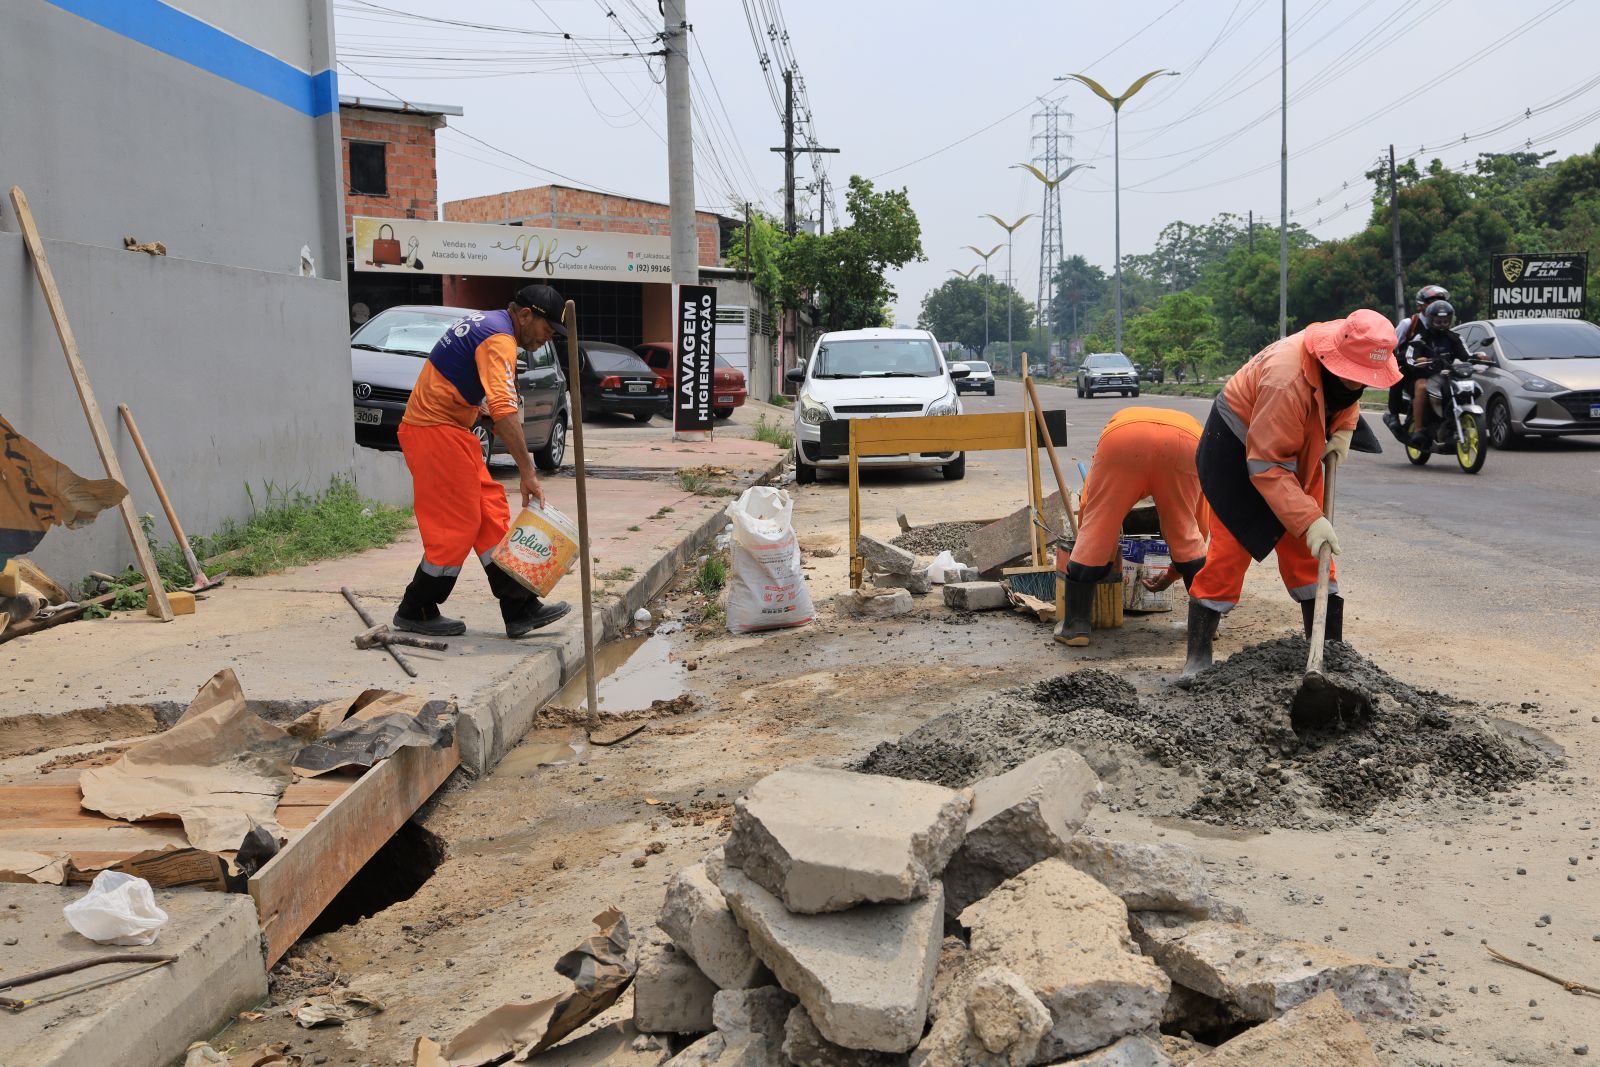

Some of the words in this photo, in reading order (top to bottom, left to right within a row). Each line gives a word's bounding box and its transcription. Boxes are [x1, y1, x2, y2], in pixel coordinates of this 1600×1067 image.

[442, 240, 466, 249] Vendas
[431, 250, 459, 259] Atacado
[468, 252, 488, 261] Varejo
[558, 262, 583, 272] Calçados
[636, 264, 650, 274] (92)
[1493, 286, 1582, 305] INSULFILM
[1496, 308, 1581, 320] ENVELOPAMENTO
[681, 301, 697, 410] LAVAGEM
[698, 294, 713, 421] HIGIENIZAÇÃO
[510, 527, 551, 557] Deline
